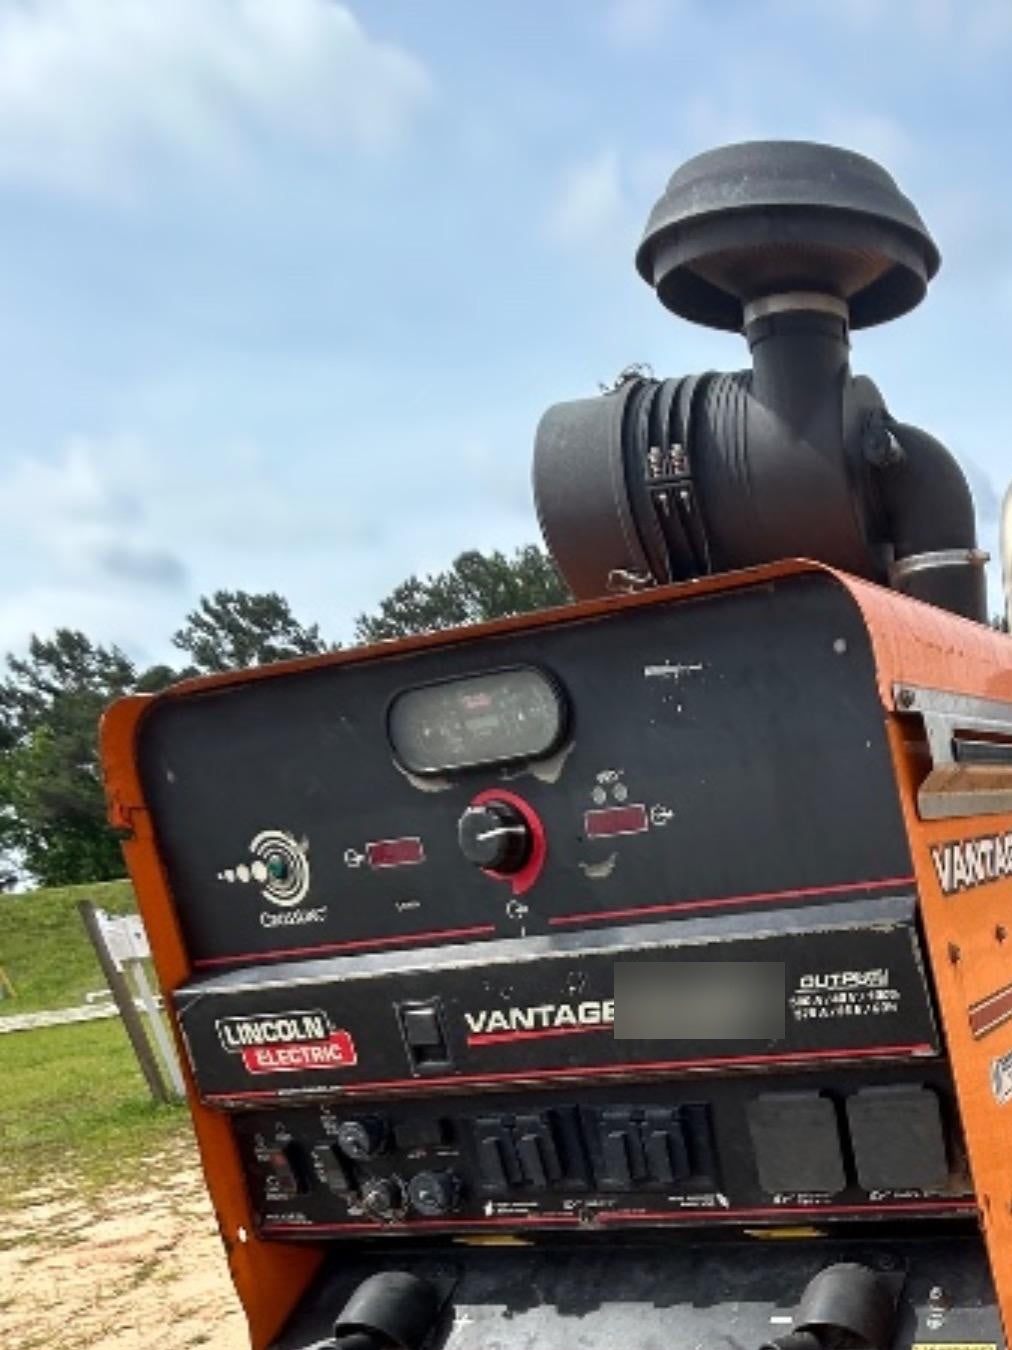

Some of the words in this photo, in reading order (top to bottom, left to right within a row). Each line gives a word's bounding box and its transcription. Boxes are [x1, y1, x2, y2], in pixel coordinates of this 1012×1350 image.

[224, 1016, 325, 1045] LINCOLN
[464, 1000, 615, 1033] VANTAGE
[255, 1043, 343, 1067] ELECTRIC
